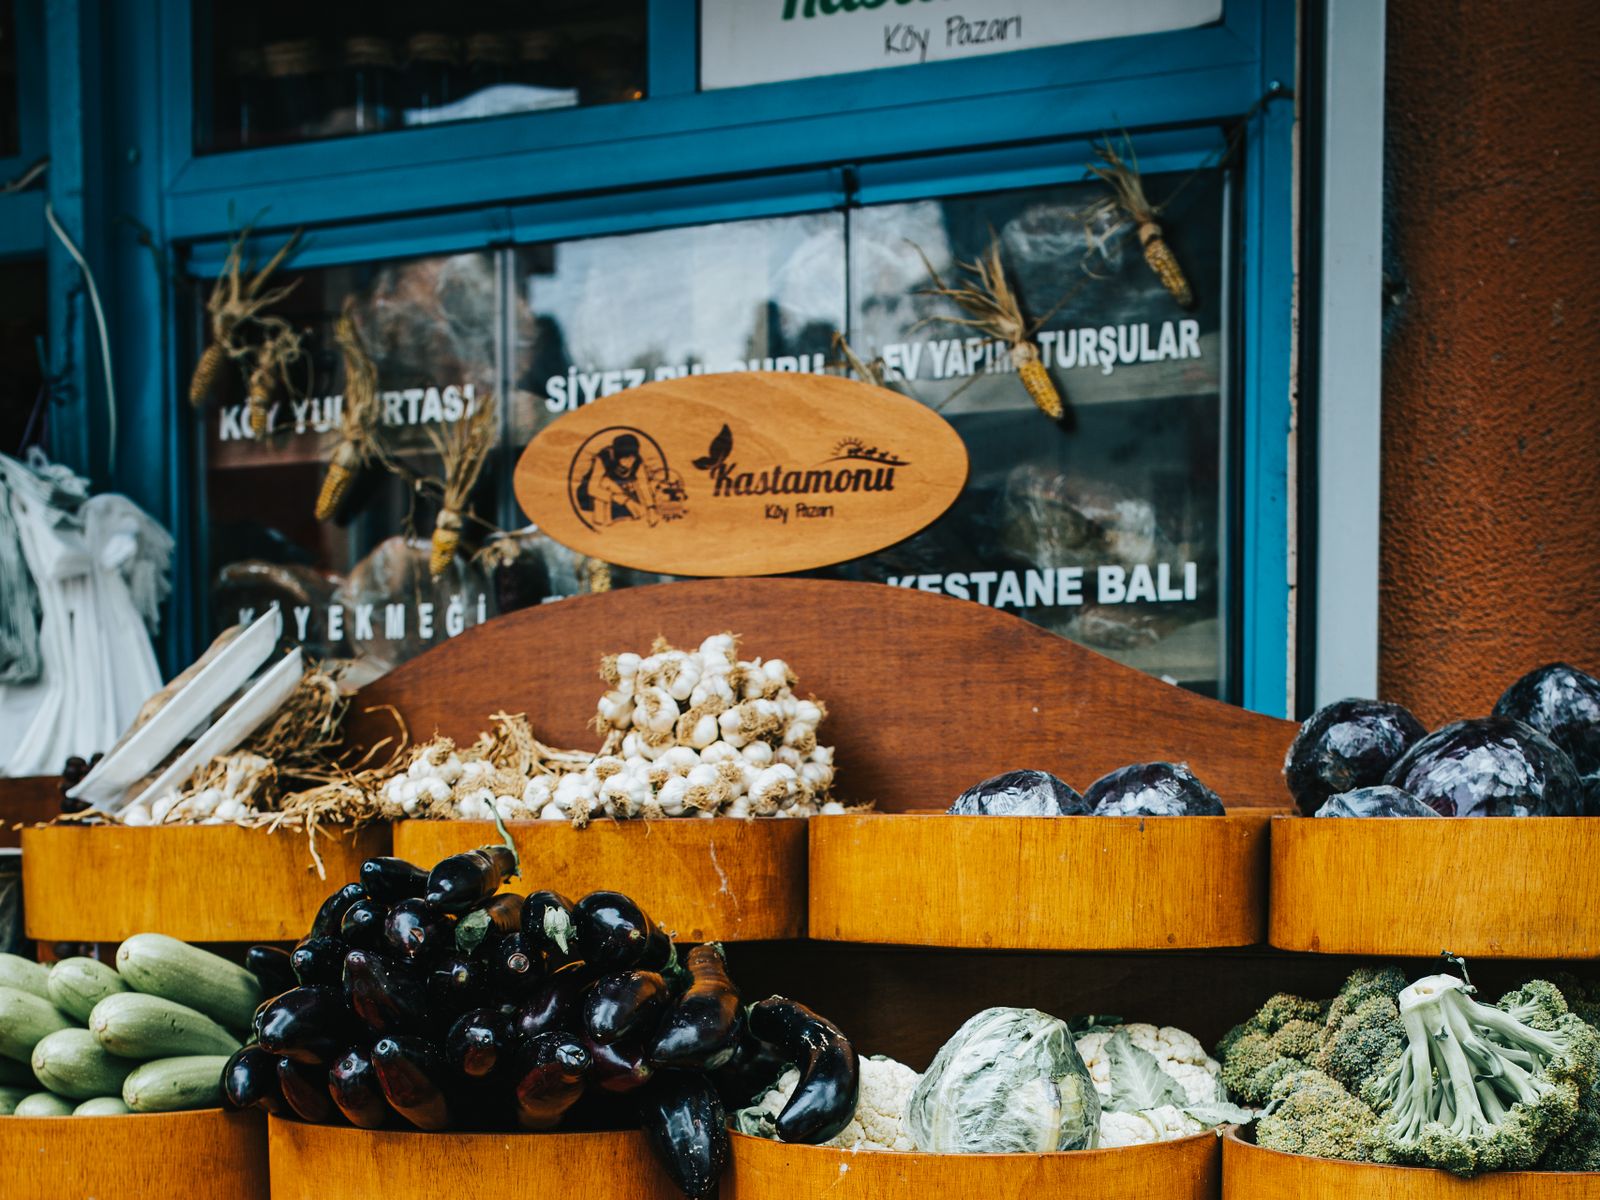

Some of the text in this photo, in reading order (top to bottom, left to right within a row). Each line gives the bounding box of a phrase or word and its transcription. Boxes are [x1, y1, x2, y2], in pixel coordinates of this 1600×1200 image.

[884, 15, 1022, 63] Köy Pazarı
[882, 319, 1201, 382] EV YAPIM TURŞULAR
[290, 384, 476, 435] YURTASI
[545, 366, 646, 413] SİYEZ
[709, 462, 895, 497] Kastamonu
[765, 503, 789, 524] Köy
[1097, 562, 1197, 605] BALI
